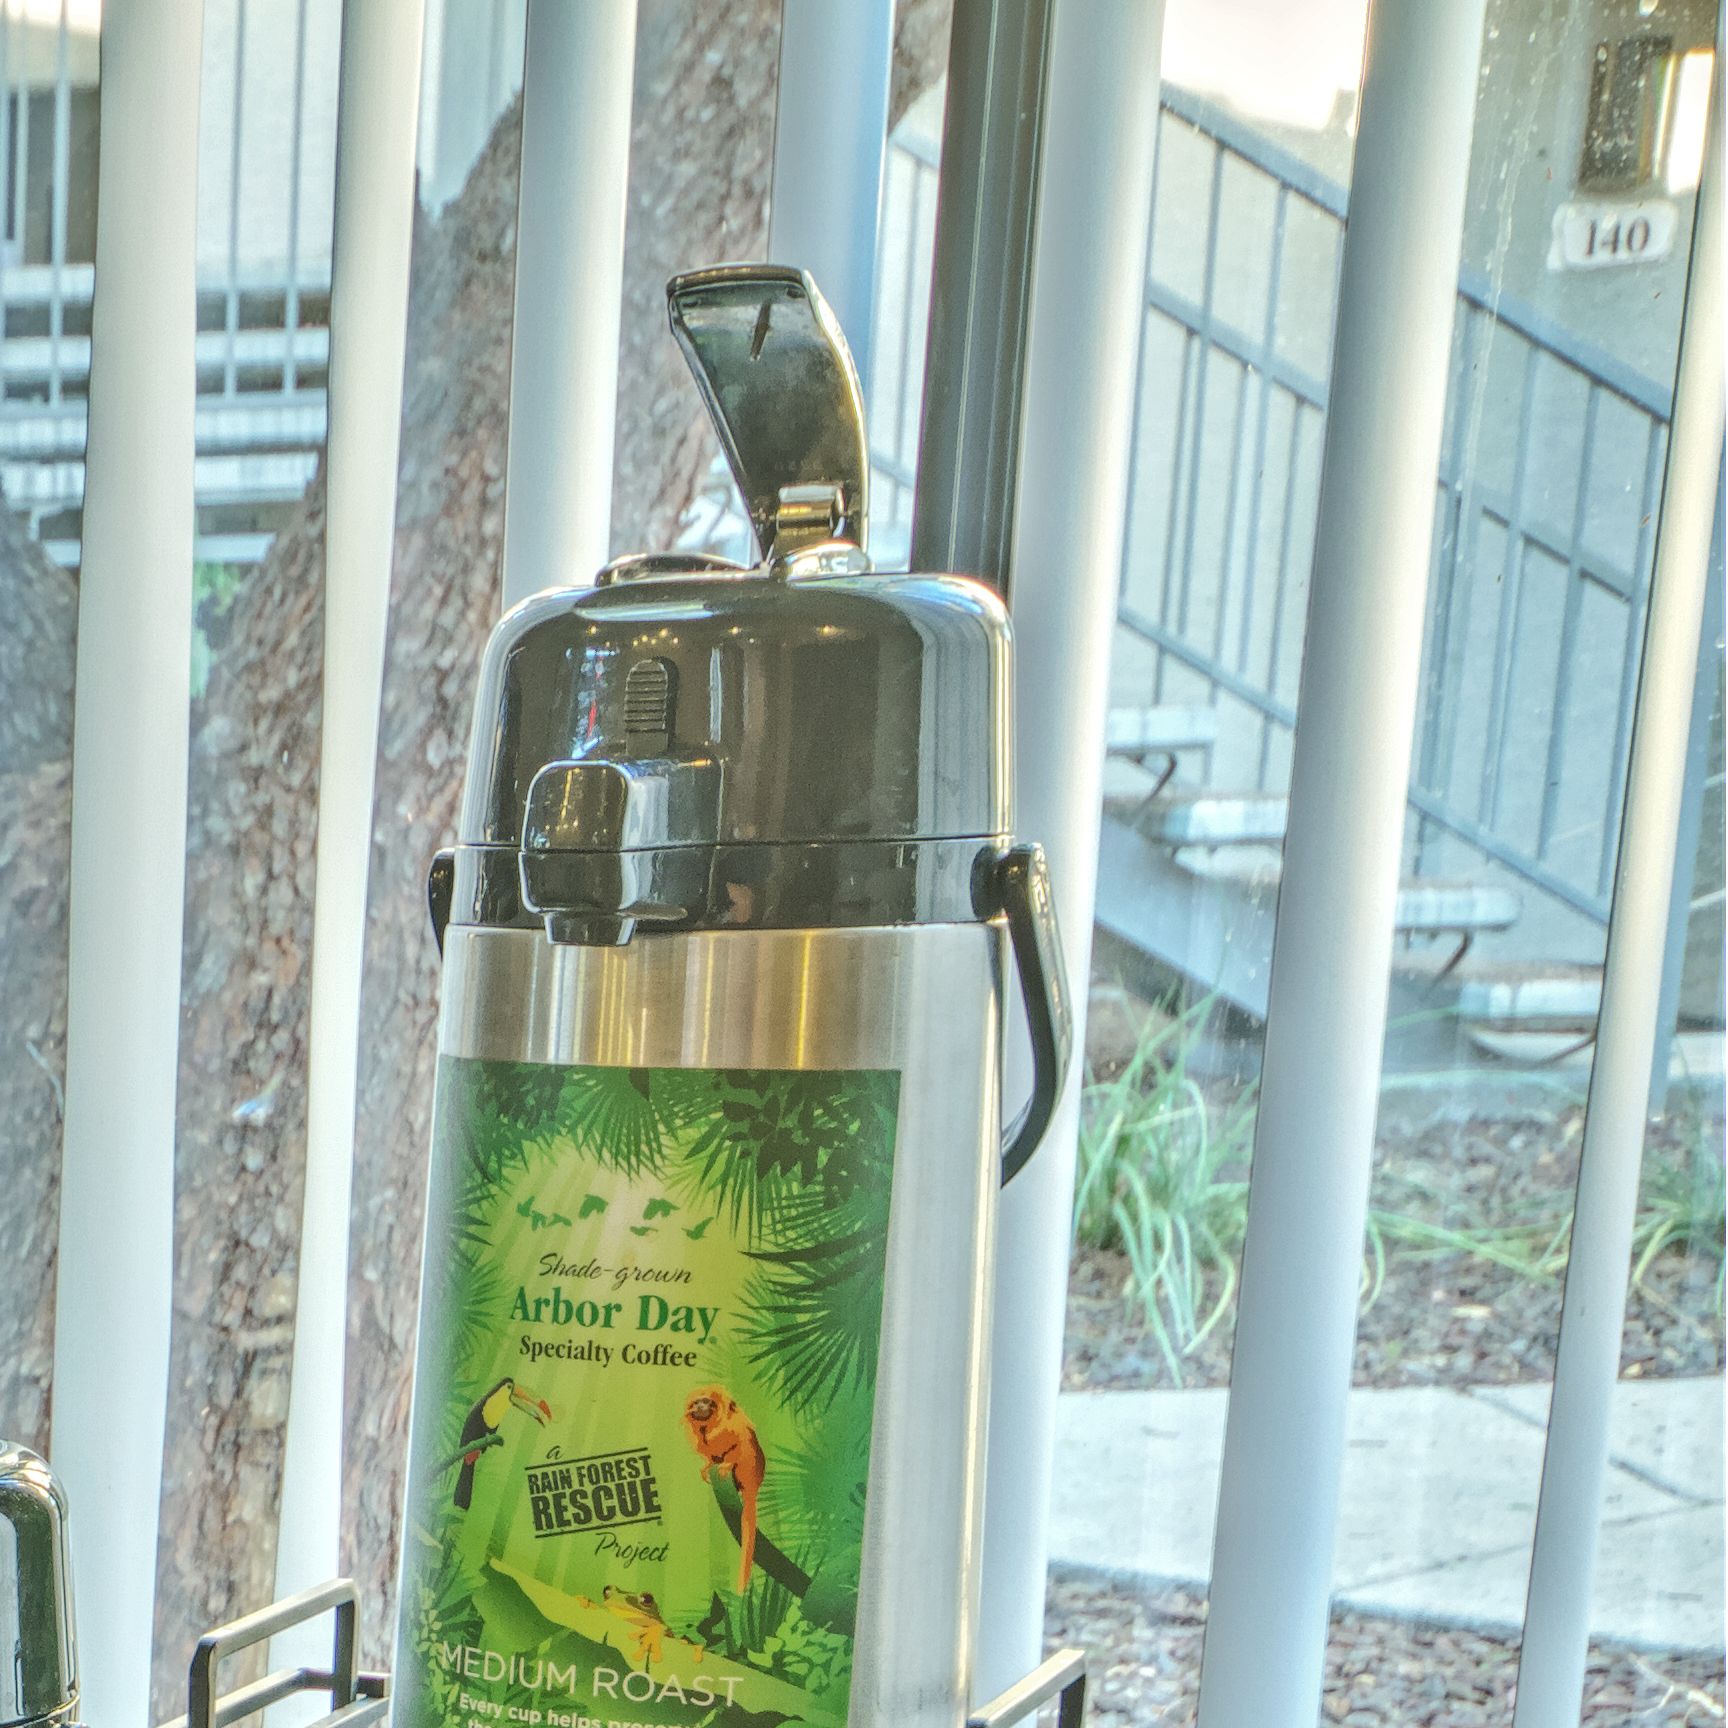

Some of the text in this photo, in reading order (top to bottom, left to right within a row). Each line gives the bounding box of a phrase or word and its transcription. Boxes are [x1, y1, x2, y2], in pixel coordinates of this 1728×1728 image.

[1586, 218, 1650, 256] 140
[539, 1252, 693, 1291] Shade-grown
[509, 1286, 720, 1343] Arbor Day
[519, 1335, 697, 1367] Specialty Coffee
[546, 1444, 564, 1460] a
[527, 1454, 651, 1494] RAIN FOREST
[531, 1479, 661, 1531] RESCUE
[594, 1531, 669, 1568] Project
[442, 1640, 744, 1707] MEDIUM ROAST
[459, 1692, 504, 1719] Every
[508, 1704, 542, 1726] cup
